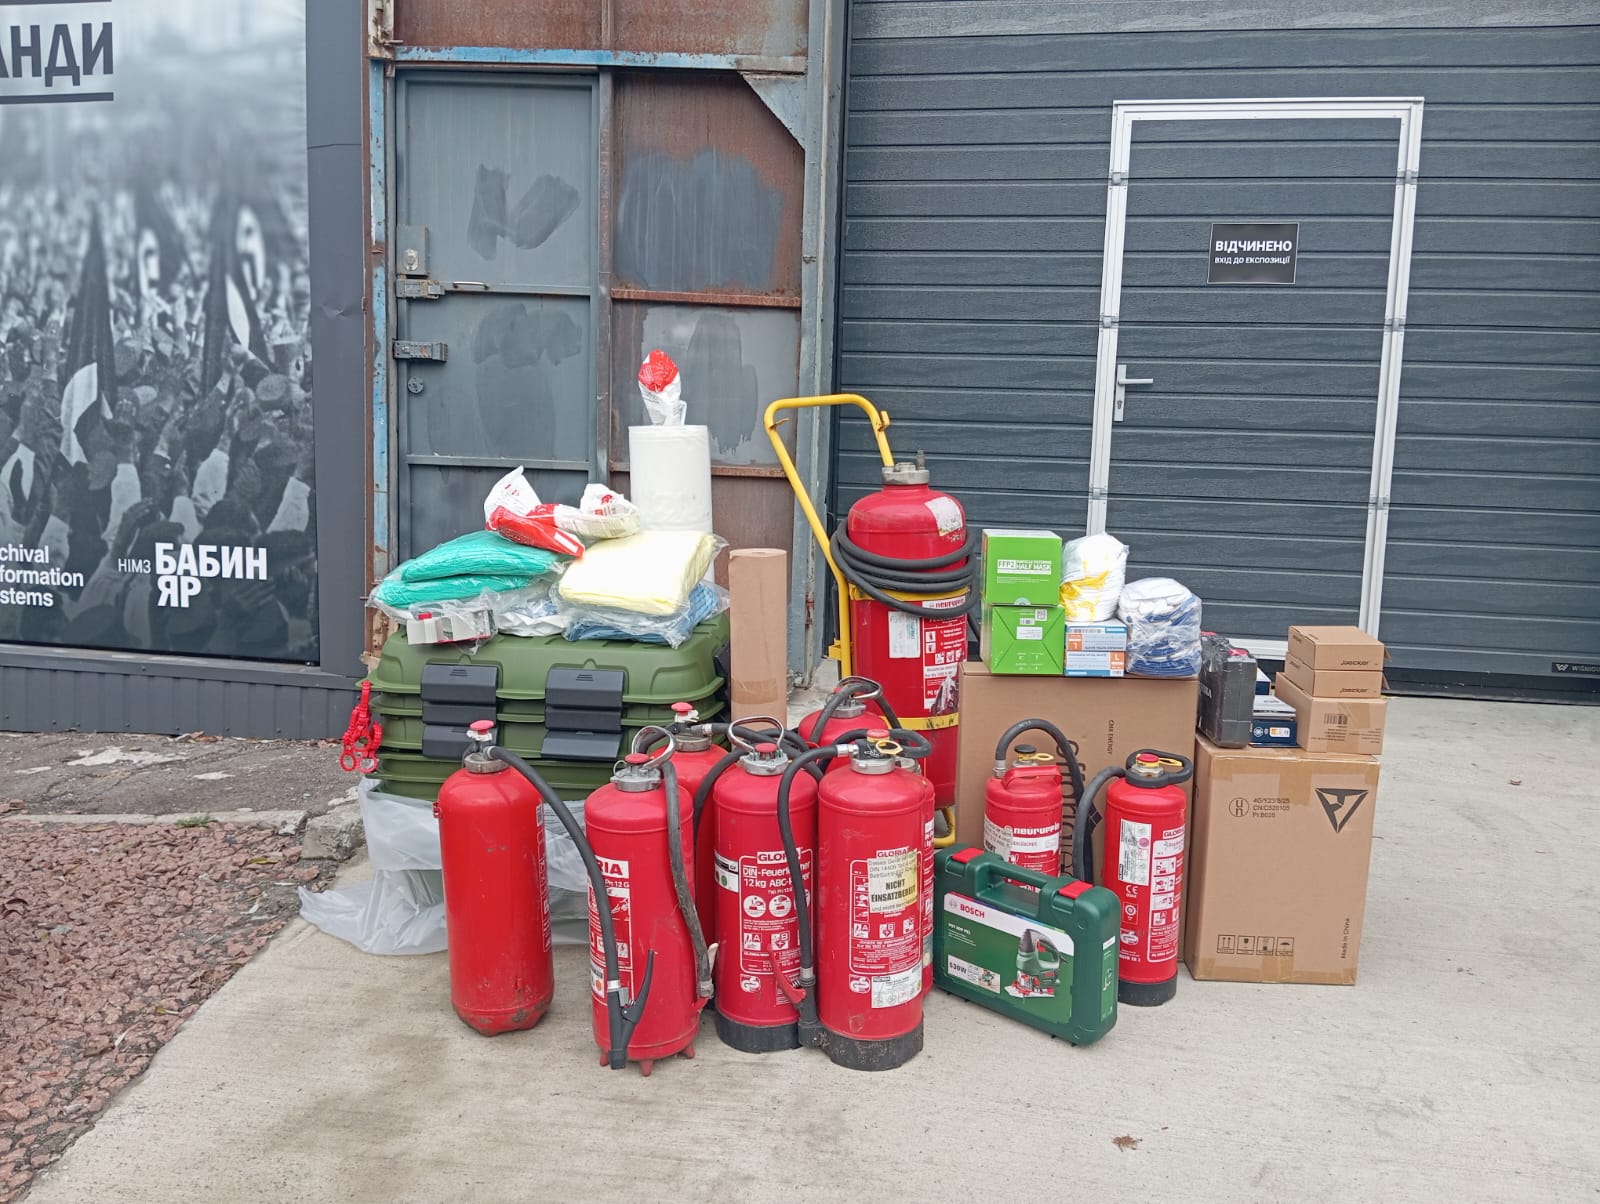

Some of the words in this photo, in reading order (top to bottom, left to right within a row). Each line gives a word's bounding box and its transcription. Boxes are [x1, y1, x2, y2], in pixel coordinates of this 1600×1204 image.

[1215, 240, 1292, 253] ВІДЧИНЕНО
[155, 542, 267, 580] БАБИН
[157, 575, 202, 608] ЯР
[877, 848, 907, 858] GLORIA
[886, 879, 906, 890] NICHT
[871, 885, 916, 902] EINSATZBEREIT
[959, 904, 985, 919] BOSCH
